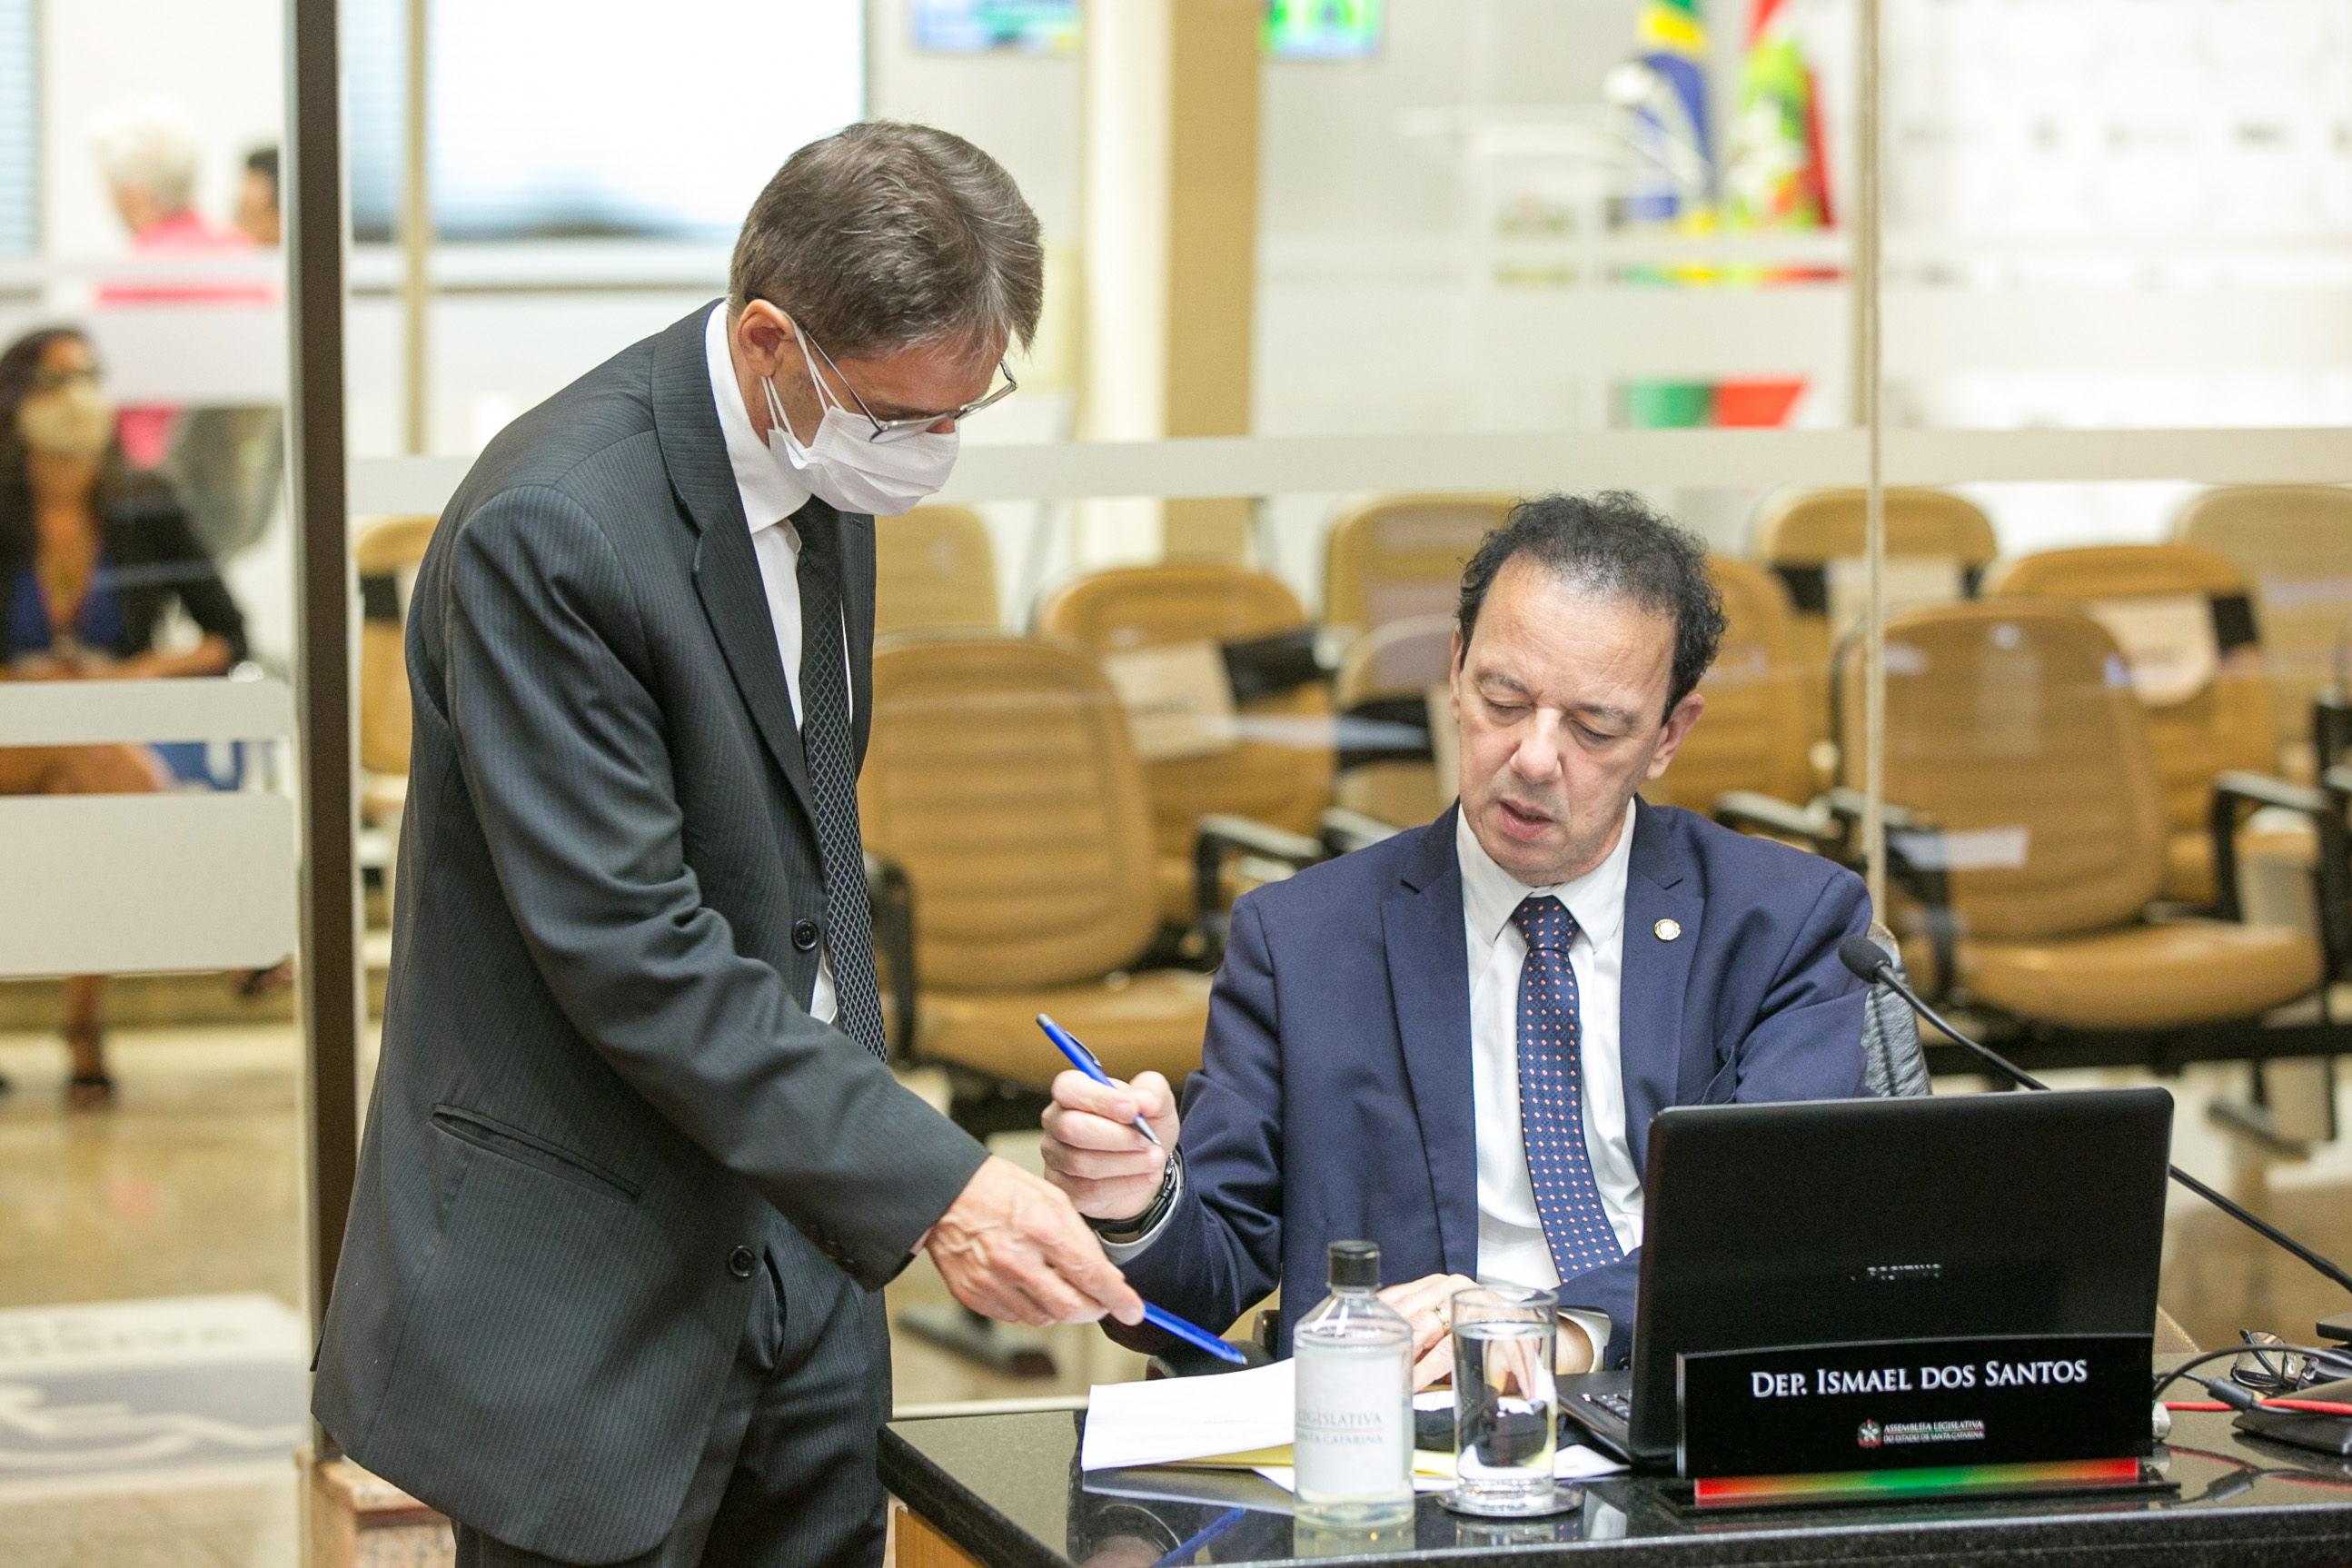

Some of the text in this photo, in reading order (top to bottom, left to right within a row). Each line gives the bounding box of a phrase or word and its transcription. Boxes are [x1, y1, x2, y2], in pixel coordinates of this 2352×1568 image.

[1752, 1360, 2089, 1398] DEP. ISMAEL DOS SANTOS
[1884, 1421, 1984, 1433] ASSEMBLEIA LEGISLATIVA
[1883, 1434, 1894, 1444] DO
[1895, 1434, 1920, 1442] ESTADO
[1920, 1433, 1930, 1441] DE
[1951, 1431, 1984, 1440] CATARINA
